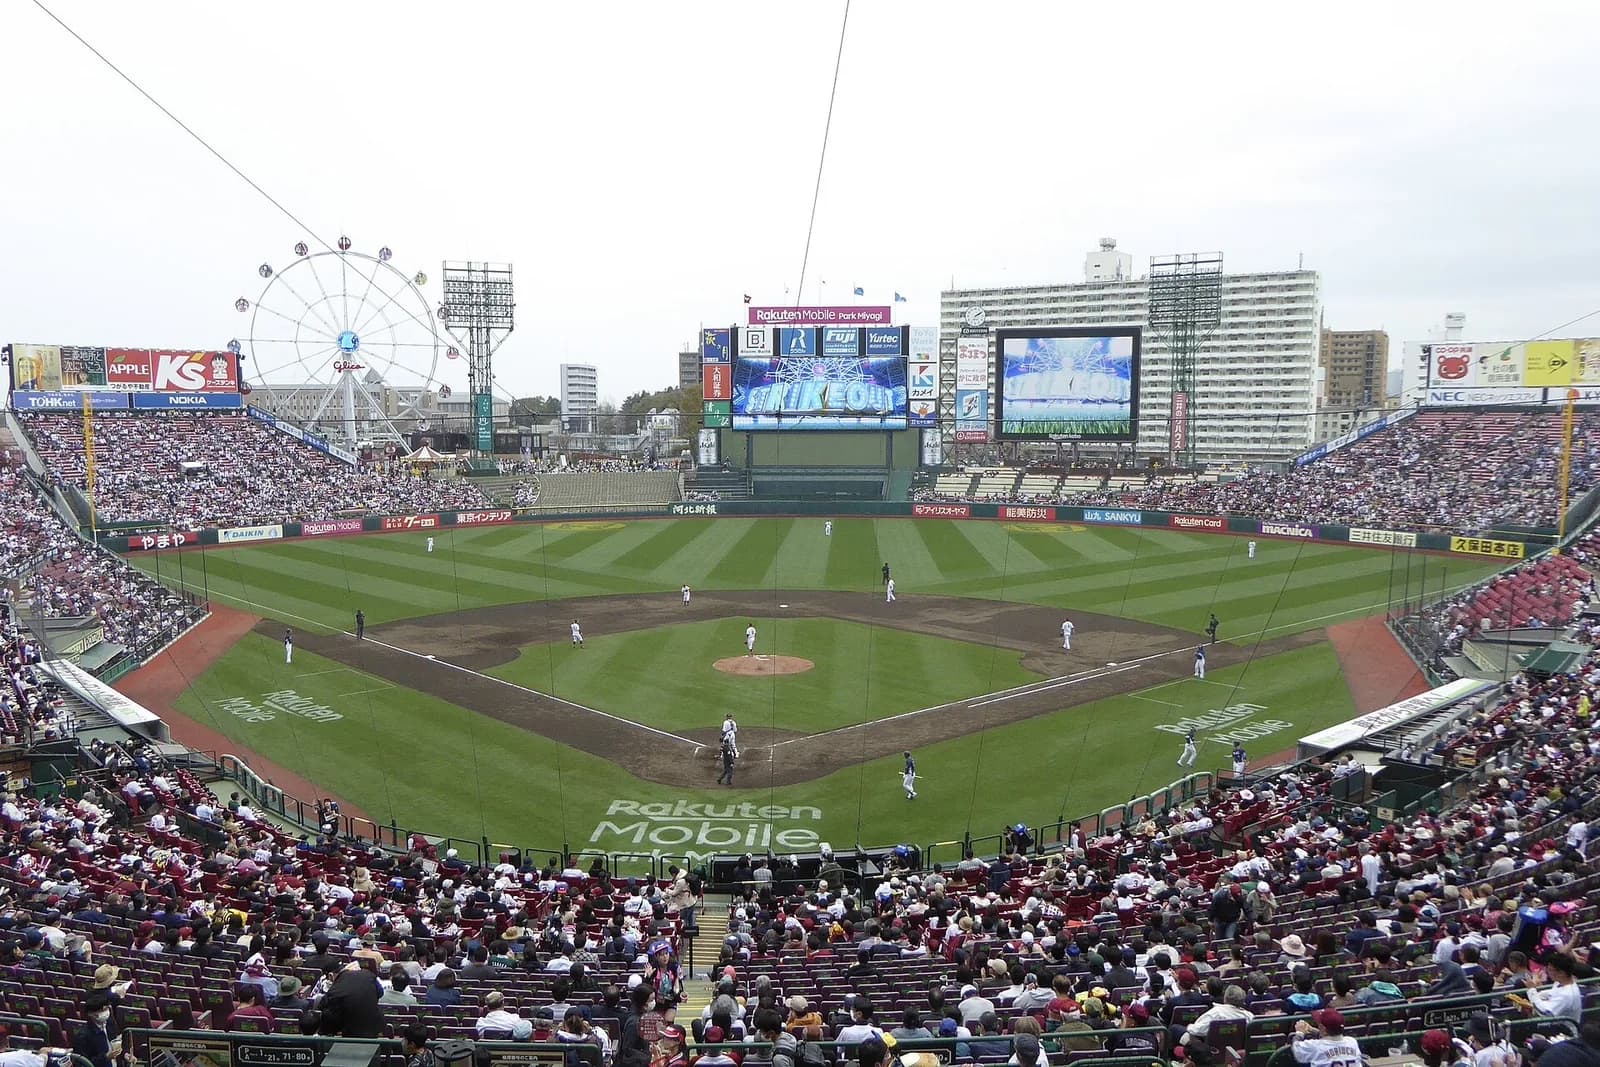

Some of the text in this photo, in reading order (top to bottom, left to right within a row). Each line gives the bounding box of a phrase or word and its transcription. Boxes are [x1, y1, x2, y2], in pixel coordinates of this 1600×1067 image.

[756, 309, 883, 322] Rakuten Mobile Park Miyagi
[825, 329, 857, 343] Fuji
[868, 332, 899, 343] Yurtec
[108, 363, 150, 375] APPLE
[333, 361, 365, 373] Glico
[912, 389, 933, 397] カメイ
[1430, 391, 1465, 402] NEC
[168, 396, 208, 404] NOKIA
[1174, 394, 1184, 449] 三井のリハウス
[672, 504, 718, 515] 河北新報
[923, 505, 967, 516] アイリスオーヤマ
[1005, 507, 1047, 519] 能美防災
[456, 511, 512, 524] 東京インテリア
[1104, 512, 1142, 523] SANKYU
[1174, 516, 1222, 528] Rakuten Card
[304, 521, 361, 534] Rakuten Mobile
[231, 529, 265, 539] DAIKIN
[1351, 529, 1417, 547] 三井住友銀行
[141, 533, 186, 549] やまや
[1455, 538, 1520, 557] 久保田本店
[260, 689, 344, 722] Rakuten
[1204, 719, 1294, 746] Mobile
[606, 799, 822, 821] Rakuten
[589, 820, 820, 848] Mobile
